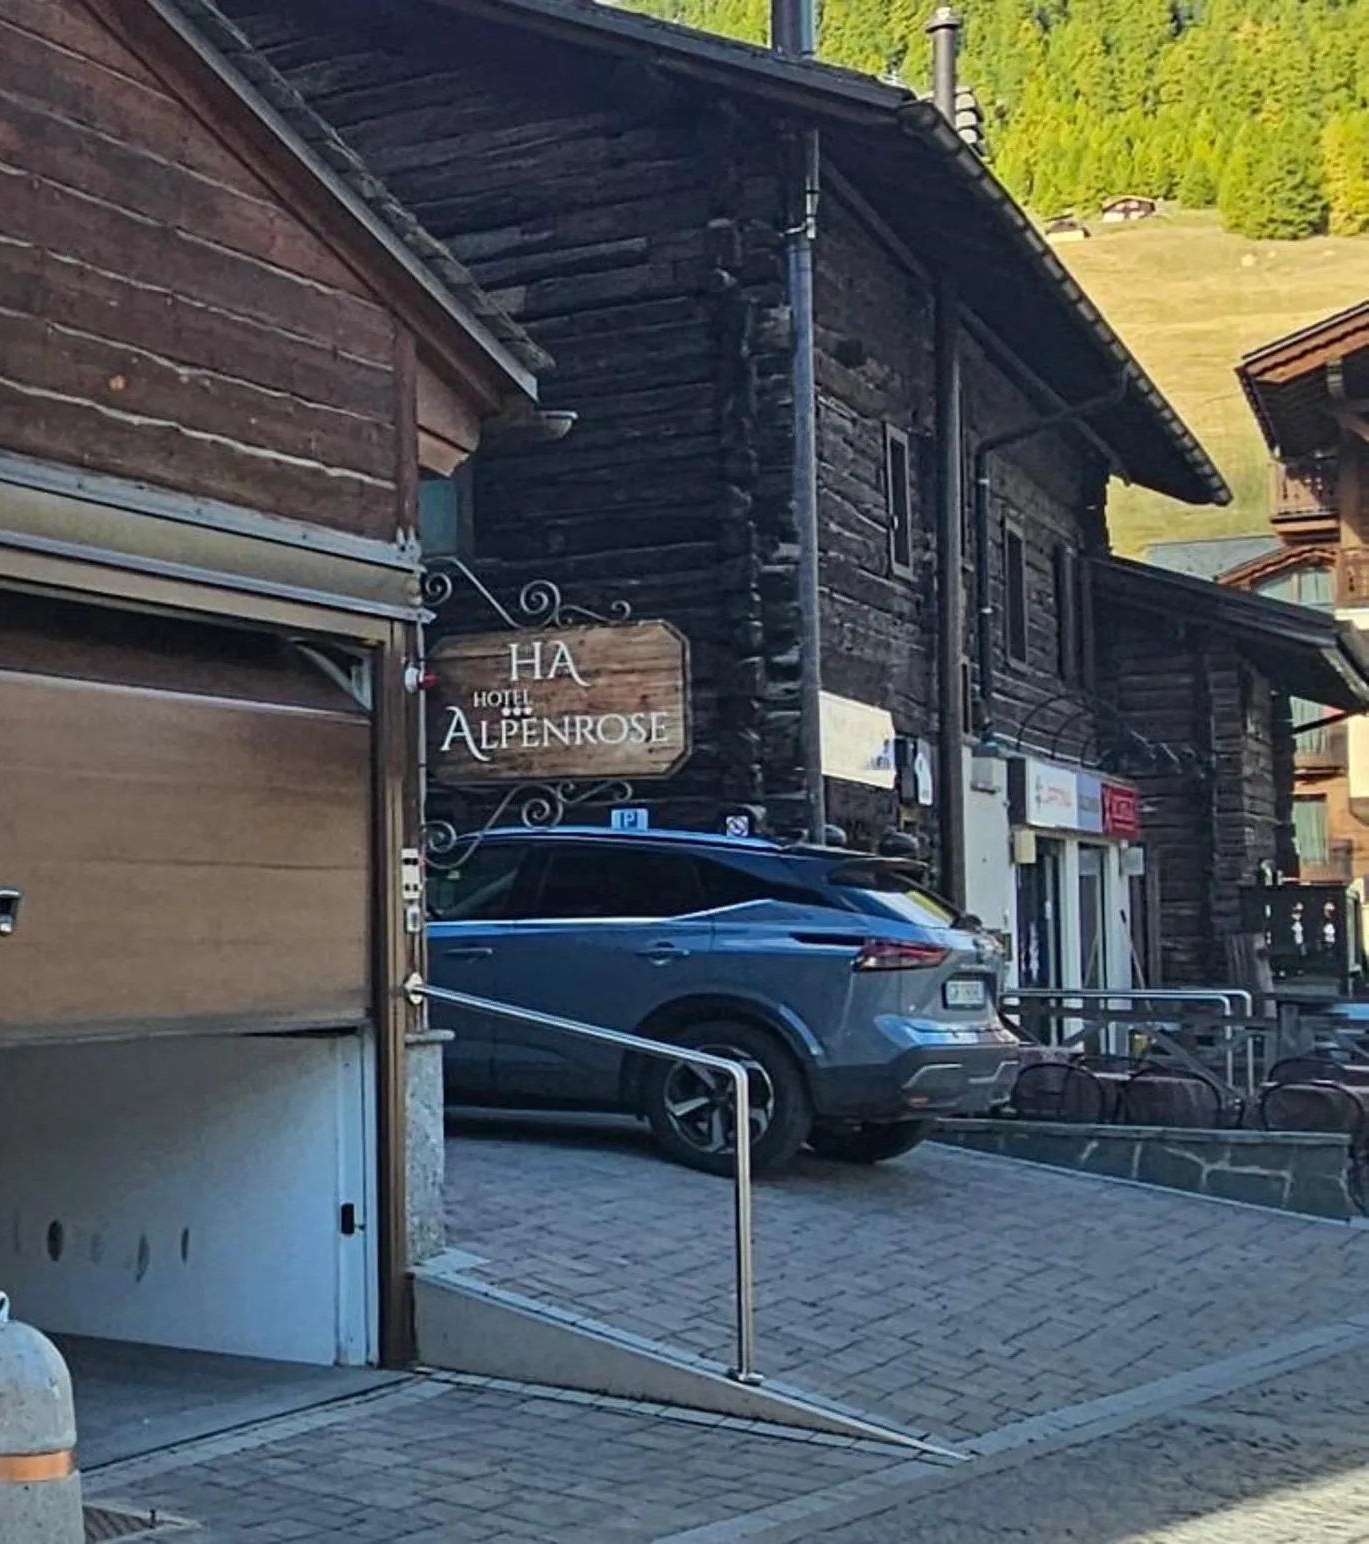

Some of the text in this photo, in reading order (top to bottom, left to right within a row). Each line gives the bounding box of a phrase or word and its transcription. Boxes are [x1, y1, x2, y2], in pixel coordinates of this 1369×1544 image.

[507, 640, 591, 687] HA
[473, 689, 532, 708] HOTEL
[439, 705, 670, 762] ALPENROSE
[623, 811, 636, 829] P
